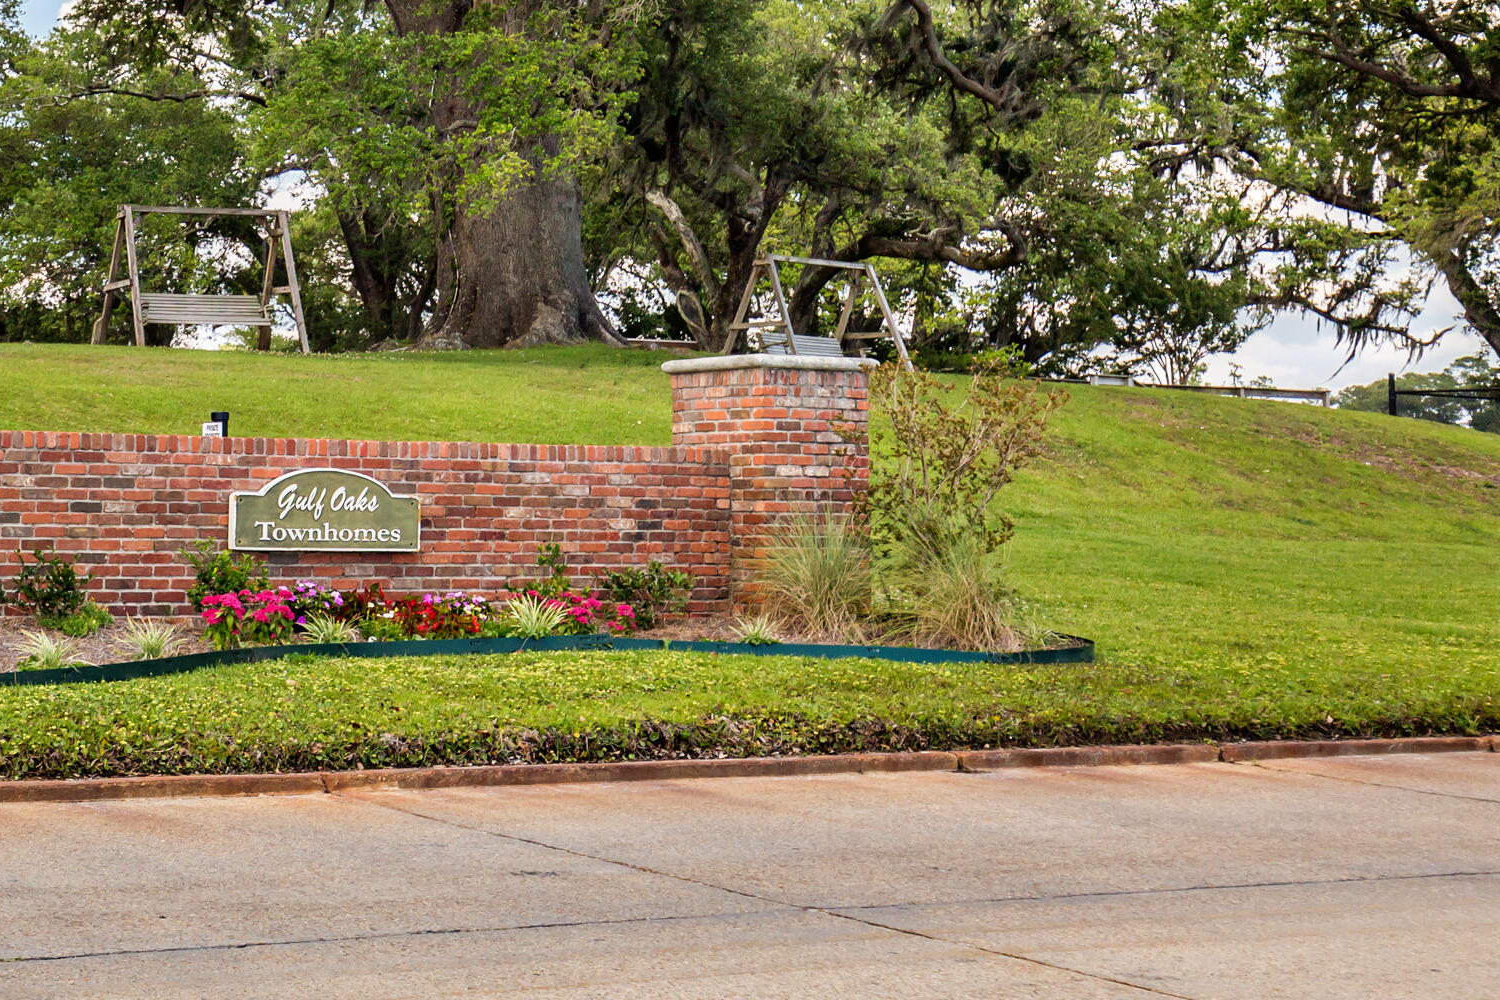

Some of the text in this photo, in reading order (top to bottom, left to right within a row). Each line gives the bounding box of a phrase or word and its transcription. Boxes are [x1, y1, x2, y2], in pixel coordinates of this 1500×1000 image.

[277, 483, 379, 520] Gulf Oaks
[254, 520, 401, 543] Townhomes
